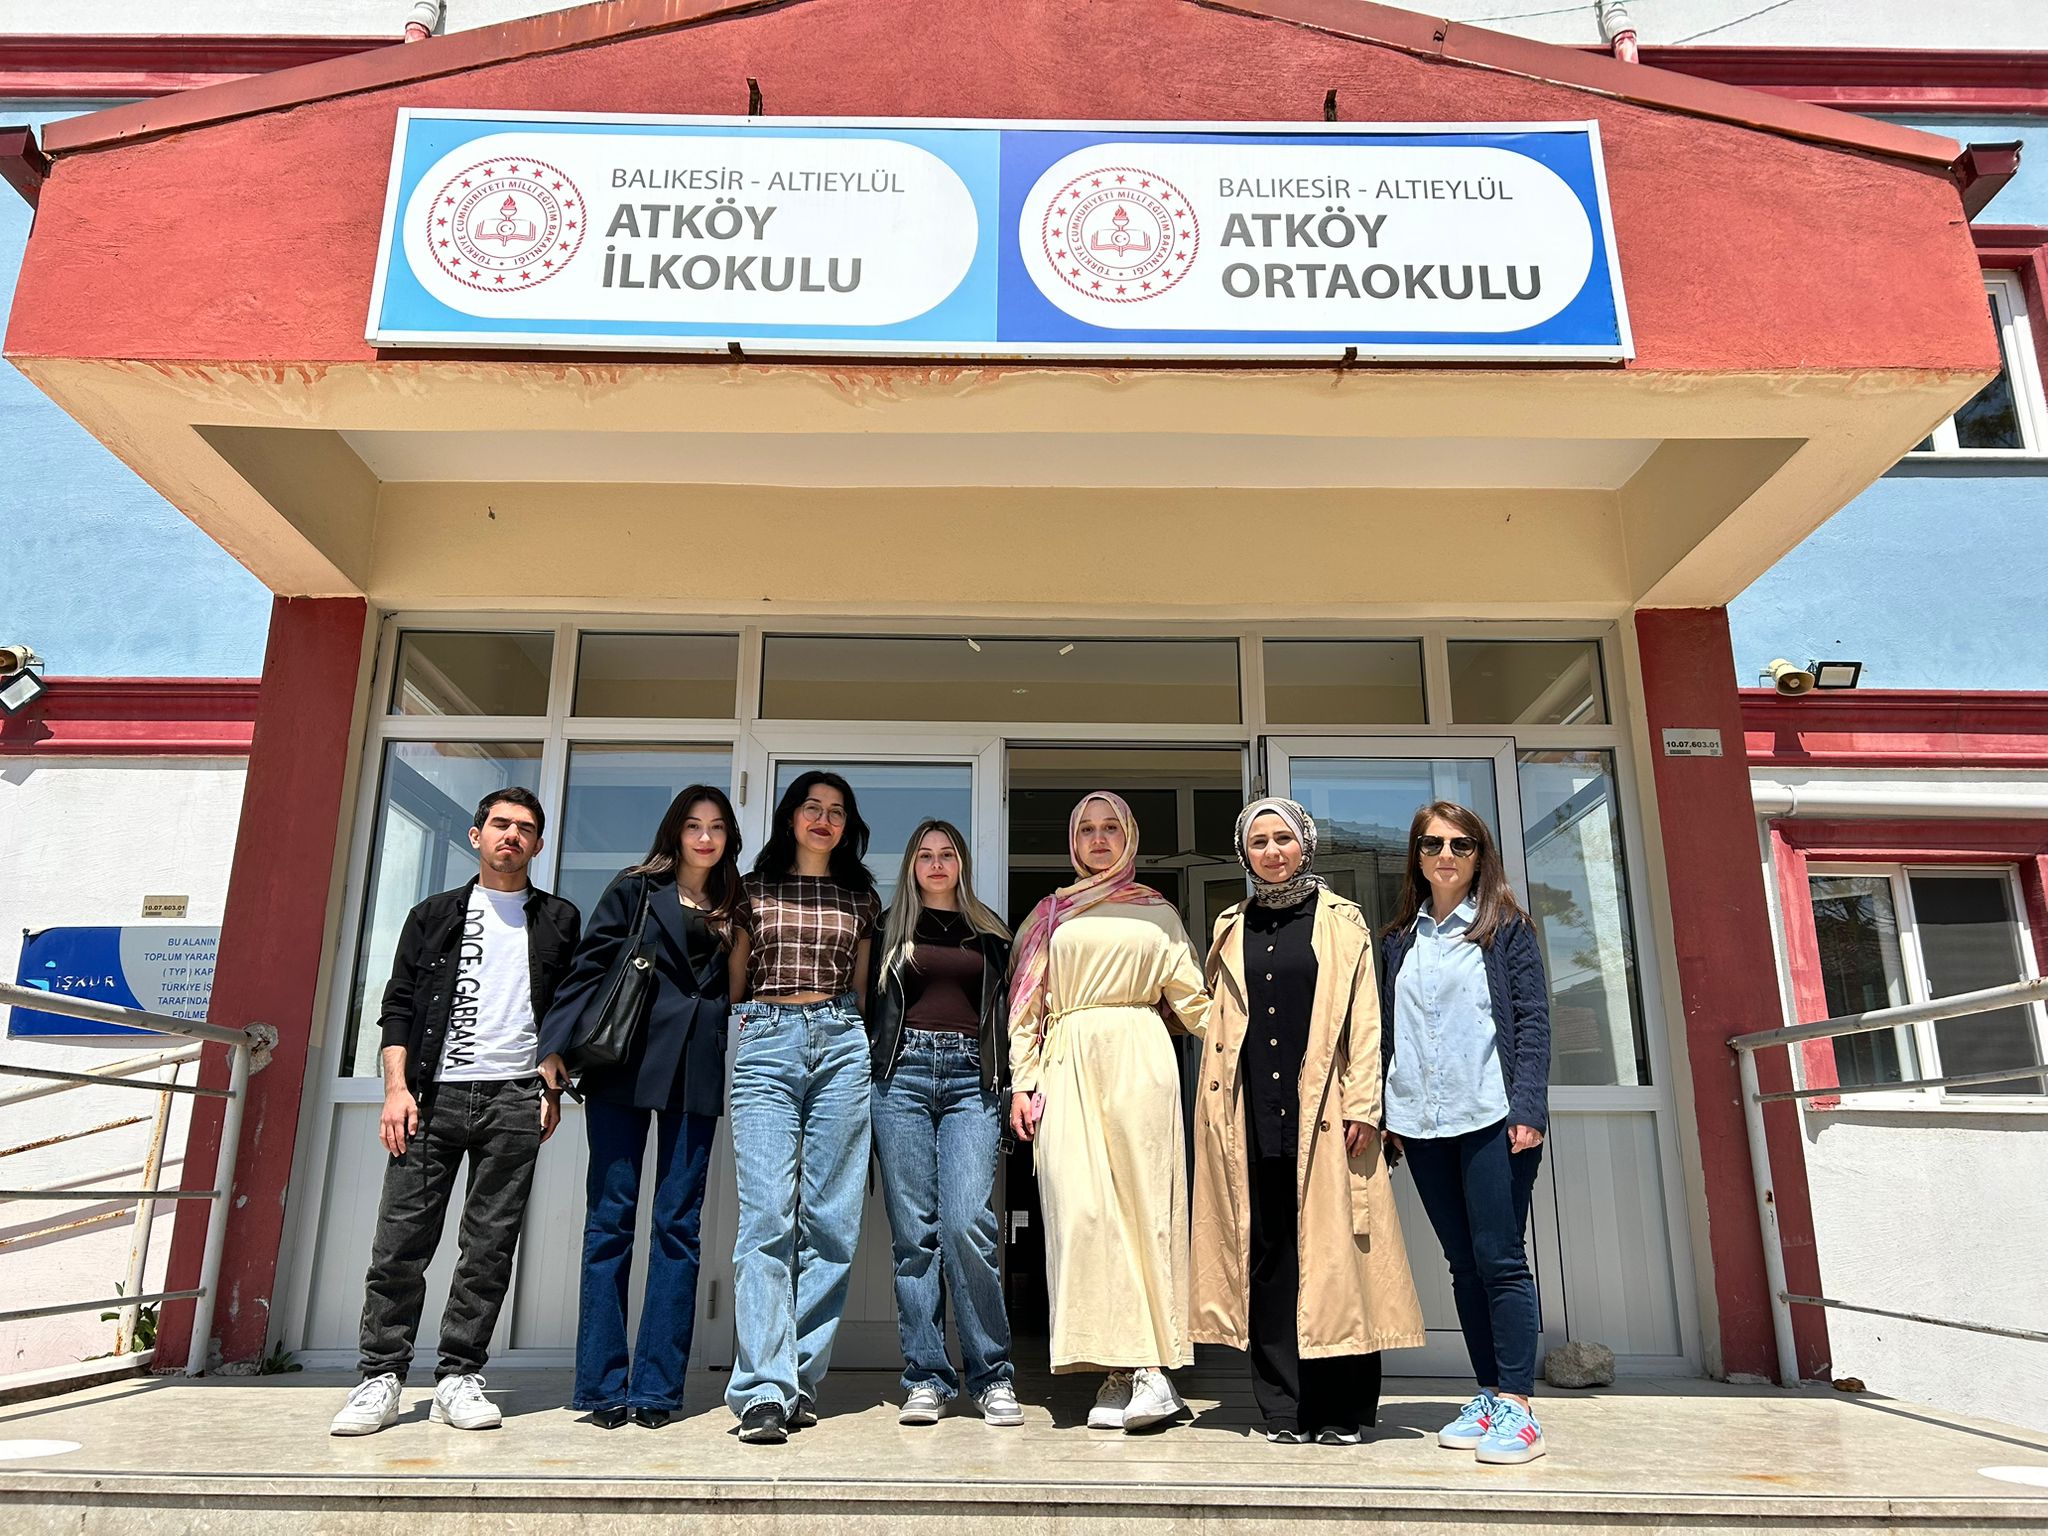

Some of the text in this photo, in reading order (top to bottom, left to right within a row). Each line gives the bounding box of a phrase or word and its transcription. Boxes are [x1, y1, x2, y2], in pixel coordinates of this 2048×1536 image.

[611, 167, 743, 190] BALIKESİR
[767, 169, 905, 193] ALTIEYLÜL
[1219, 175, 1351, 199] BALIKESİR
[1375, 177, 1513, 200] ALTIEYLÜL
[457, 181, 557, 265] TÜRKİYE CUMHURİYETİ MİLLİ EĞİTİM BAKANLIĞI
[605, 197, 778, 240] ATKÖY
[1071, 191, 1171, 275] TÜRKİYE CUMHURİYETİ MİLLİ EĞİTİM BAKANLIĞI
[1219, 206, 1388, 248] ATKÖY
[602, 245, 862, 293] İLKOKULU
[1221, 262, 1541, 300] ORTAOKULU
[144, 953, 182, 961] TOPLUM
[168, 938, 216, 946] BU ALANIN
[161, 982, 201, 991] TÜRKİYE
